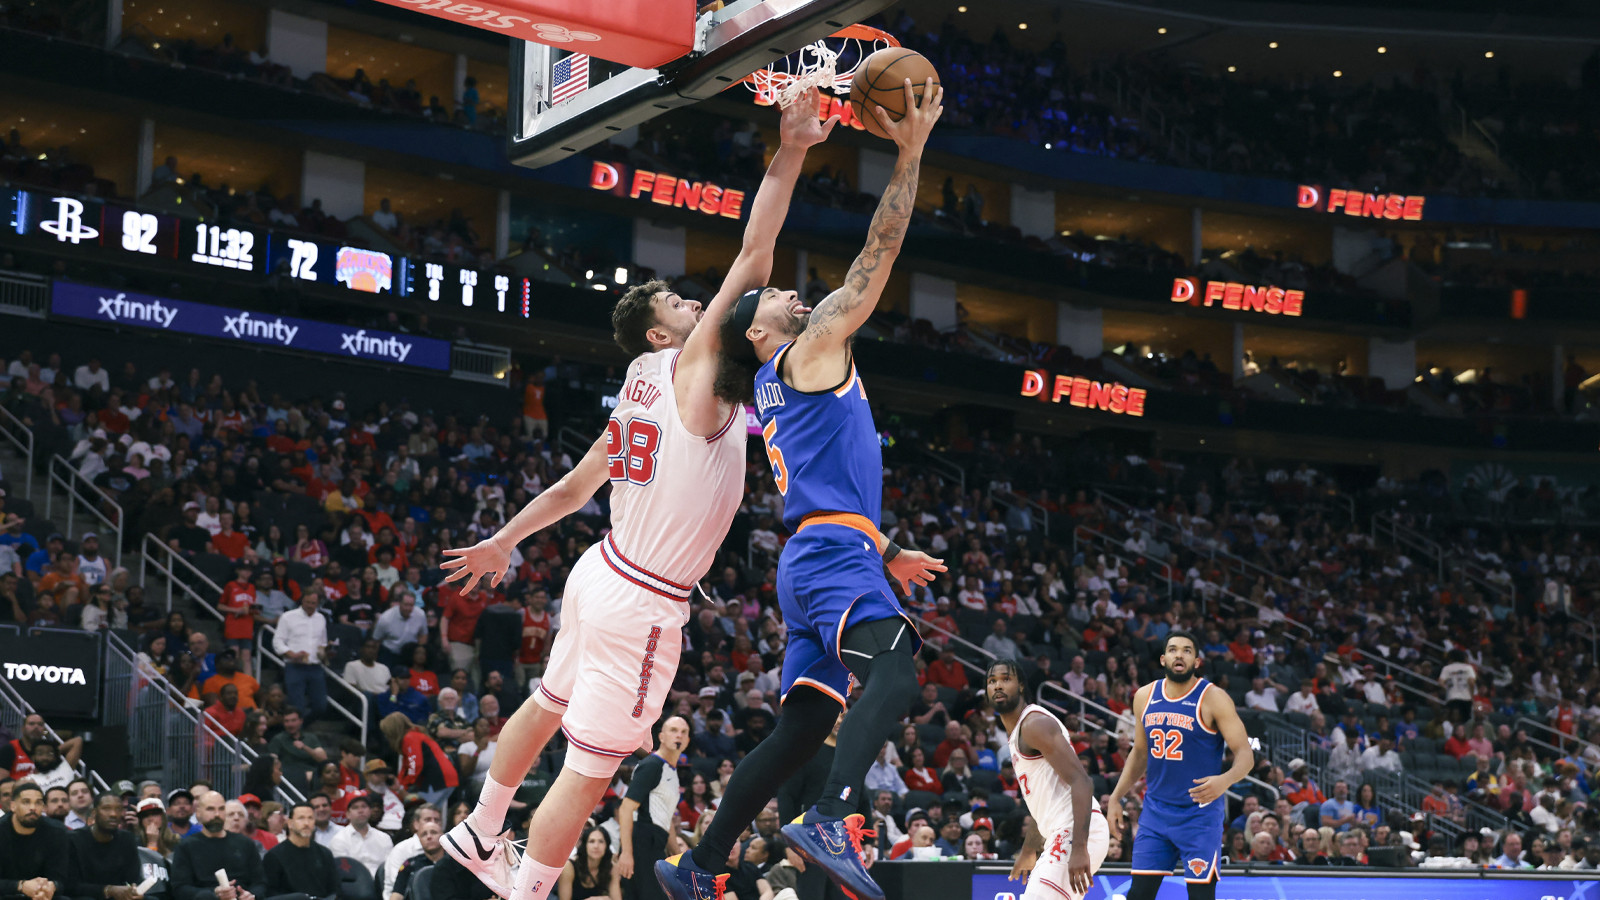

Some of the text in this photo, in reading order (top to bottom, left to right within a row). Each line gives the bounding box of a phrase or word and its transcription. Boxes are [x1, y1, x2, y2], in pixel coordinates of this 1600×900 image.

[590, 160, 745, 220] D FENSE
[1297, 185, 1425, 221] D FENSE
[122, 210, 158, 254] 92
[196, 223, 254, 263] 11:32
[288, 239, 318, 281] 72
[98, 293, 178, 328] xfinity
[497, 290, 506, 312] 1
[1171, 277, 1305, 317] D FENSE
[223, 311, 299, 345] xfinity
[341, 330, 412, 362] xfinity
[622, 379, 662, 411] NGUN
[1020, 370, 1147, 417] D FENSE
[607, 416, 663, 487] 28
[762, 415, 789, 497] 5
[3, 662, 87, 686] TOYOTA
[631, 624, 662, 718] ROCKETS
[1144, 711, 1196, 732] NEW YORK
[1149, 728, 1184, 761] 32
[1018, 773, 1031, 795] 7
